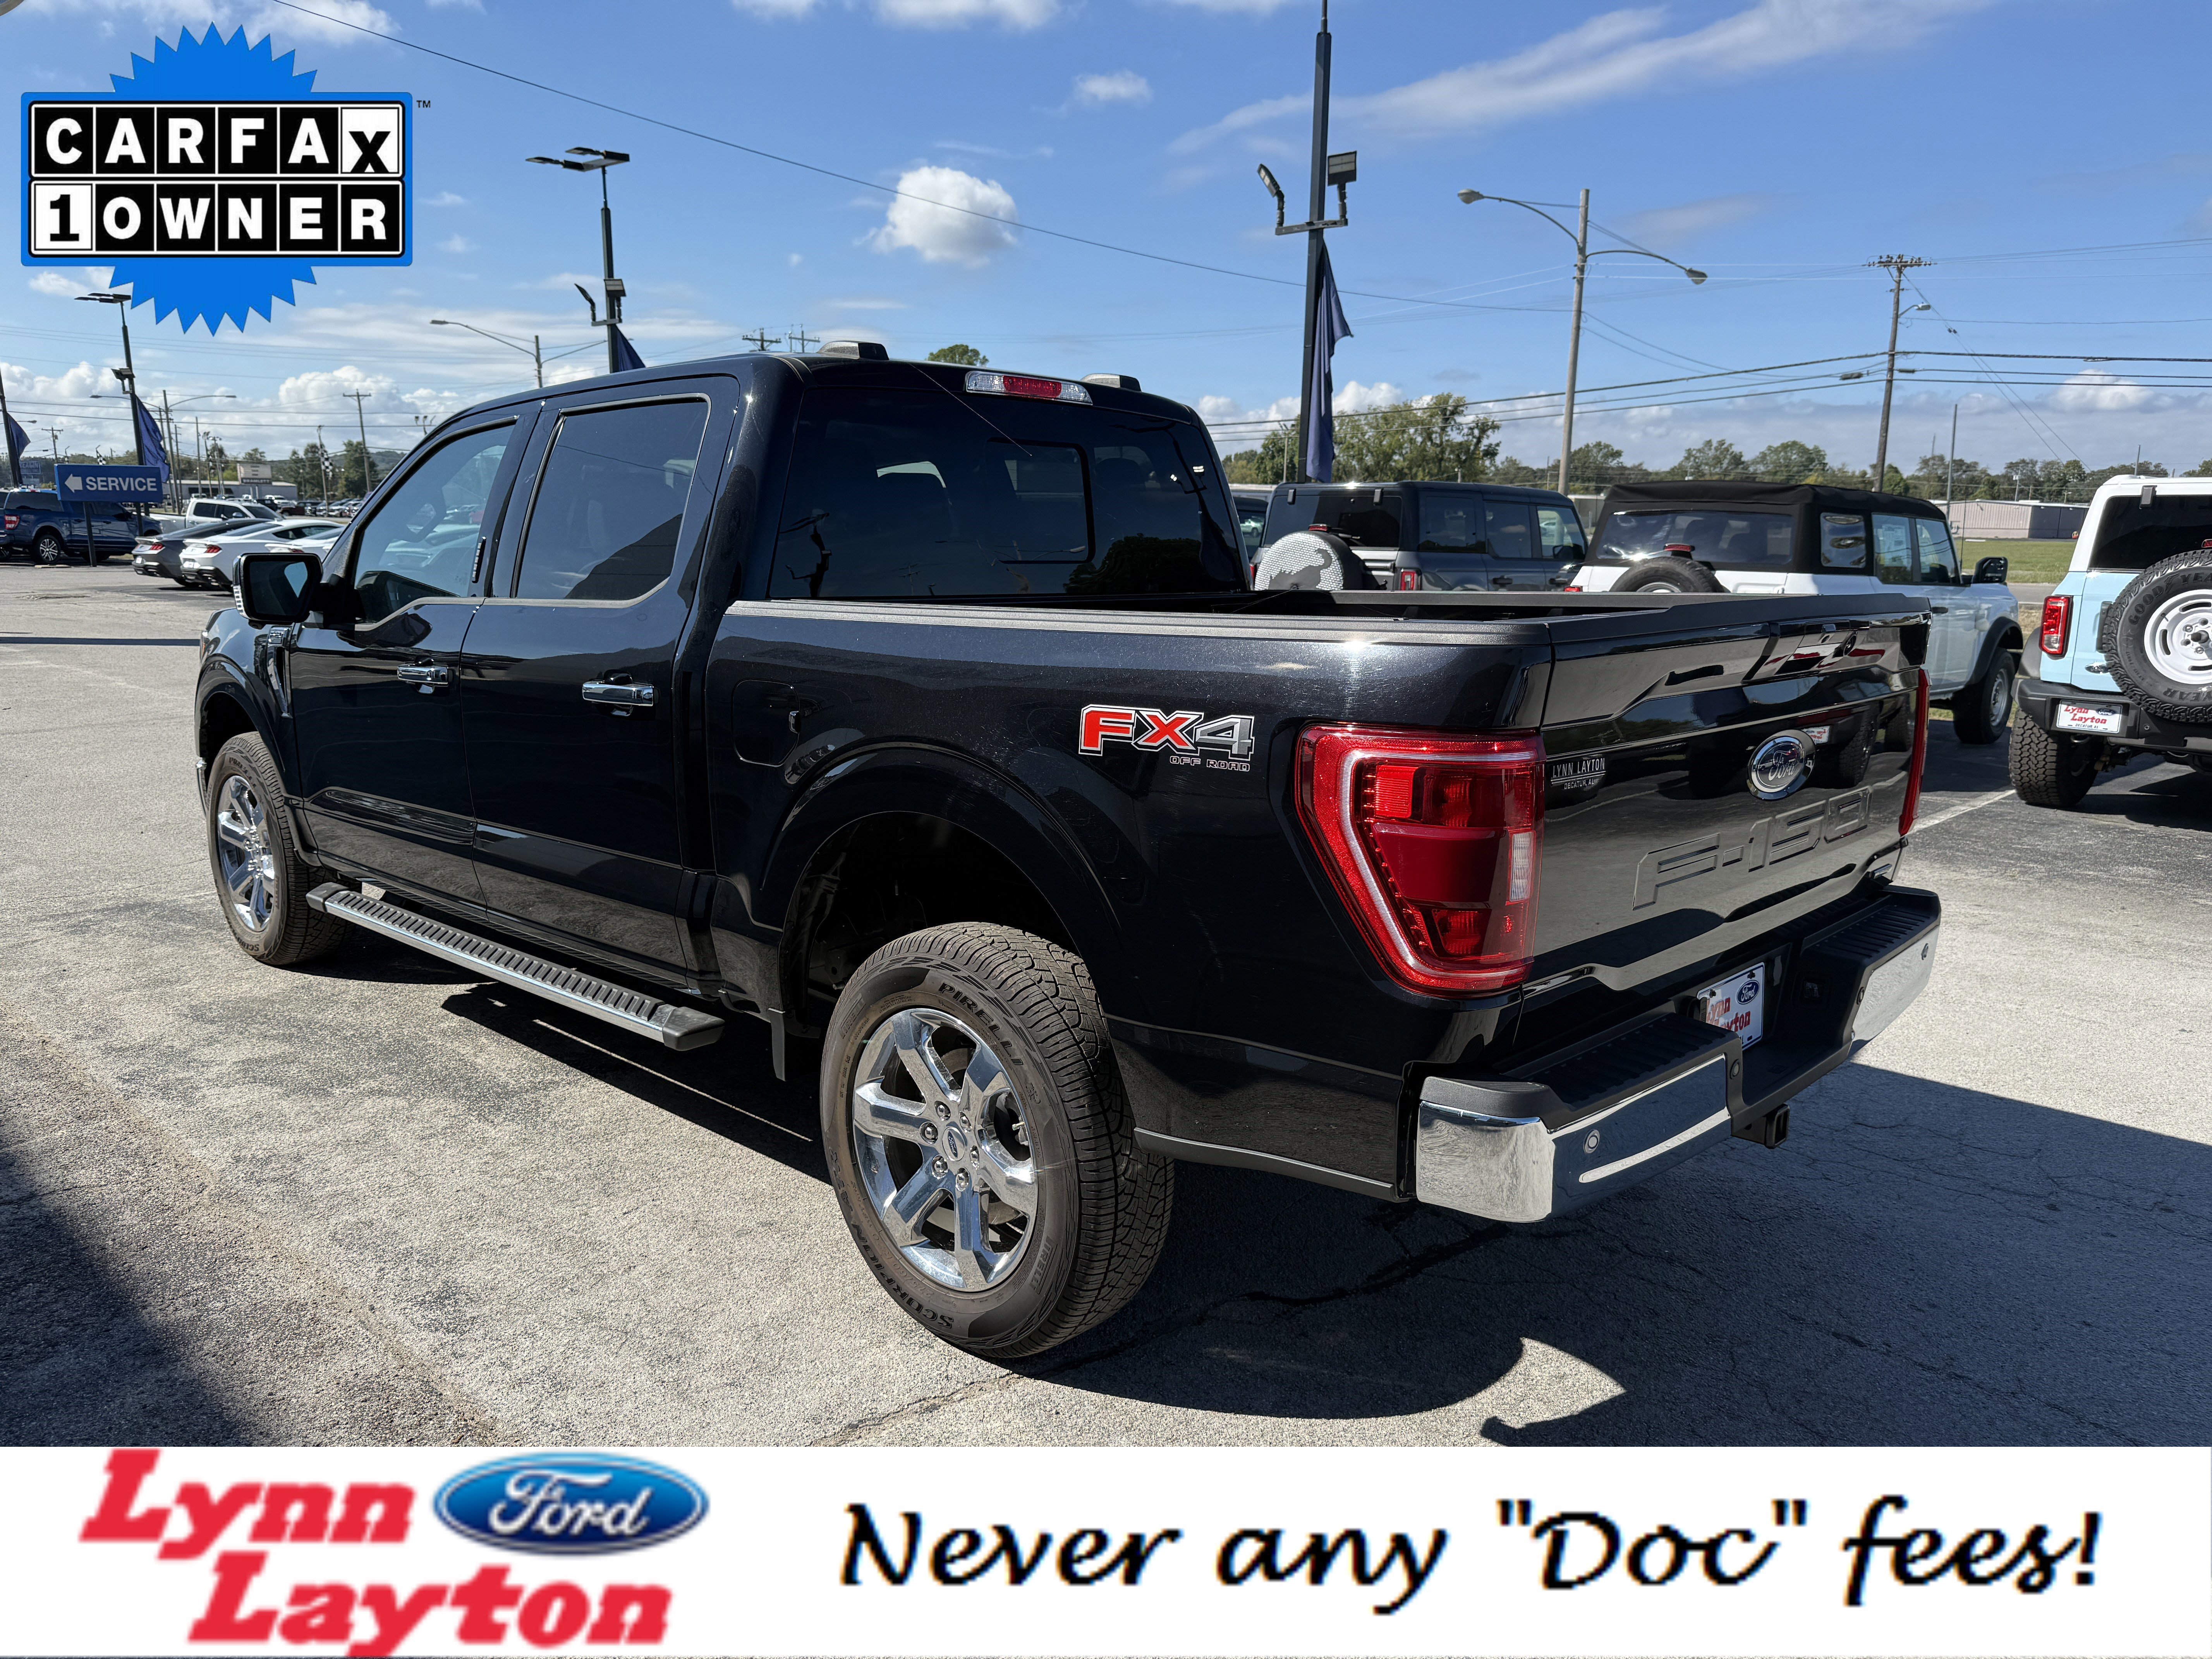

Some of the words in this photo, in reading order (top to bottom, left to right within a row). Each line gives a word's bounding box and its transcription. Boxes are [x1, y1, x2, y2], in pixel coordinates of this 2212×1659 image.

[86, 476, 157, 491] SERVICE
[2064, 704, 2089, 714] Lynn
[2071, 713, 2107, 724] Layton
[1079, 704, 1255, 761] FX4
[1170, 756, 1201, 766] OFF
[1206, 759, 1250, 772] ROAD
[1553, 763, 1573, 778] LYNN
[1577, 758, 1605, 774] LAYTON
[1768, 749, 1798, 781] Ford
[1632, 786, 1873, 910] F-150
[1741, 983, 1755, 1003] Ford
[938, 982, 1024, 1065] PIRELLI
[948, 1136, 957, 1154] Ford
[852, 1223, 954, 1329] SCORPION
